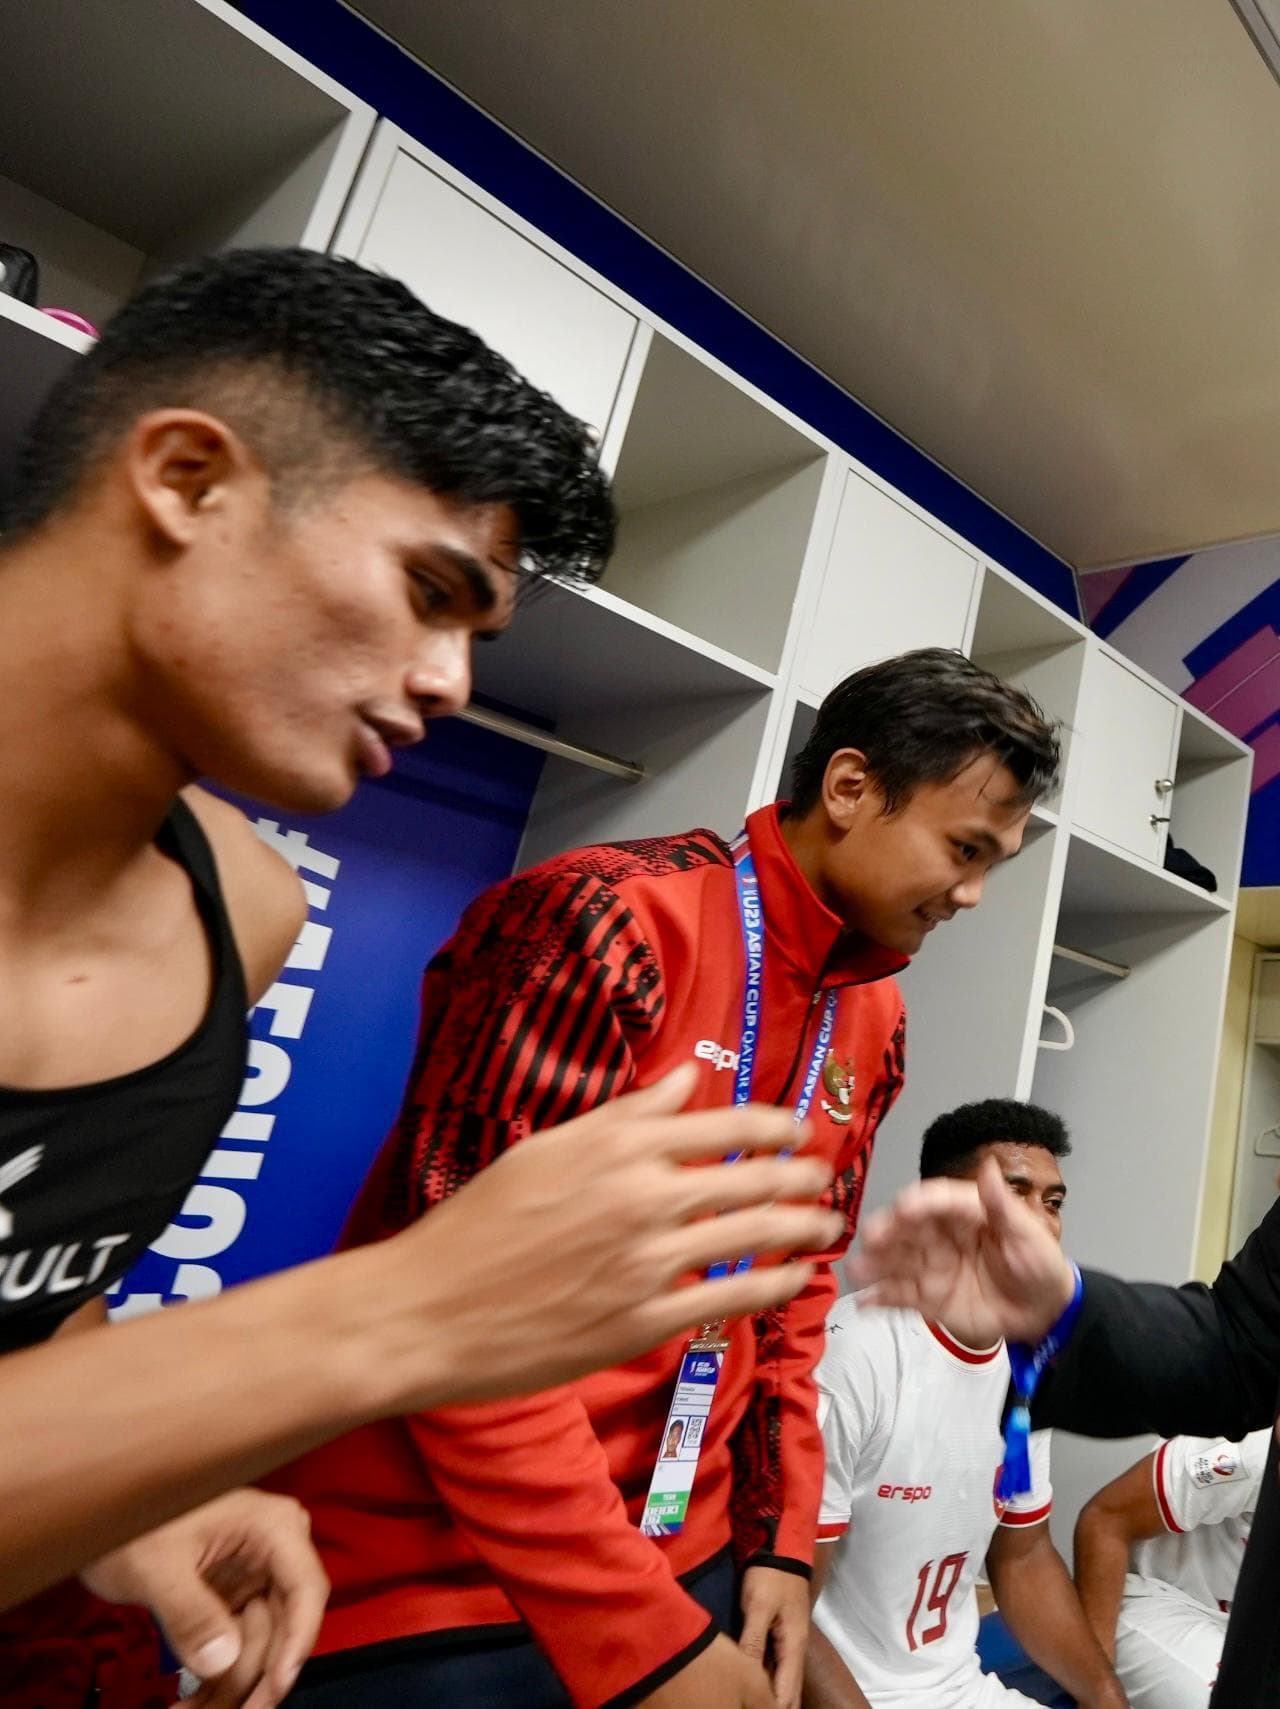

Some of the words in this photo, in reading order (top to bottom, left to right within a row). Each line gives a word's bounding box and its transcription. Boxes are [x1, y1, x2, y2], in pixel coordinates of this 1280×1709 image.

[746, 930, 762, 985] ASIAN
[745, 989, 760, 1027] CUP
[803, 1045, 827, 1098] ASIAN
[819, 1009, 833, 1044] CUP
[0, 1233, 131, 1302] ULT
[877, 1484, 932, 1504] erspo
[906, 1551, 970, 1652] 19
